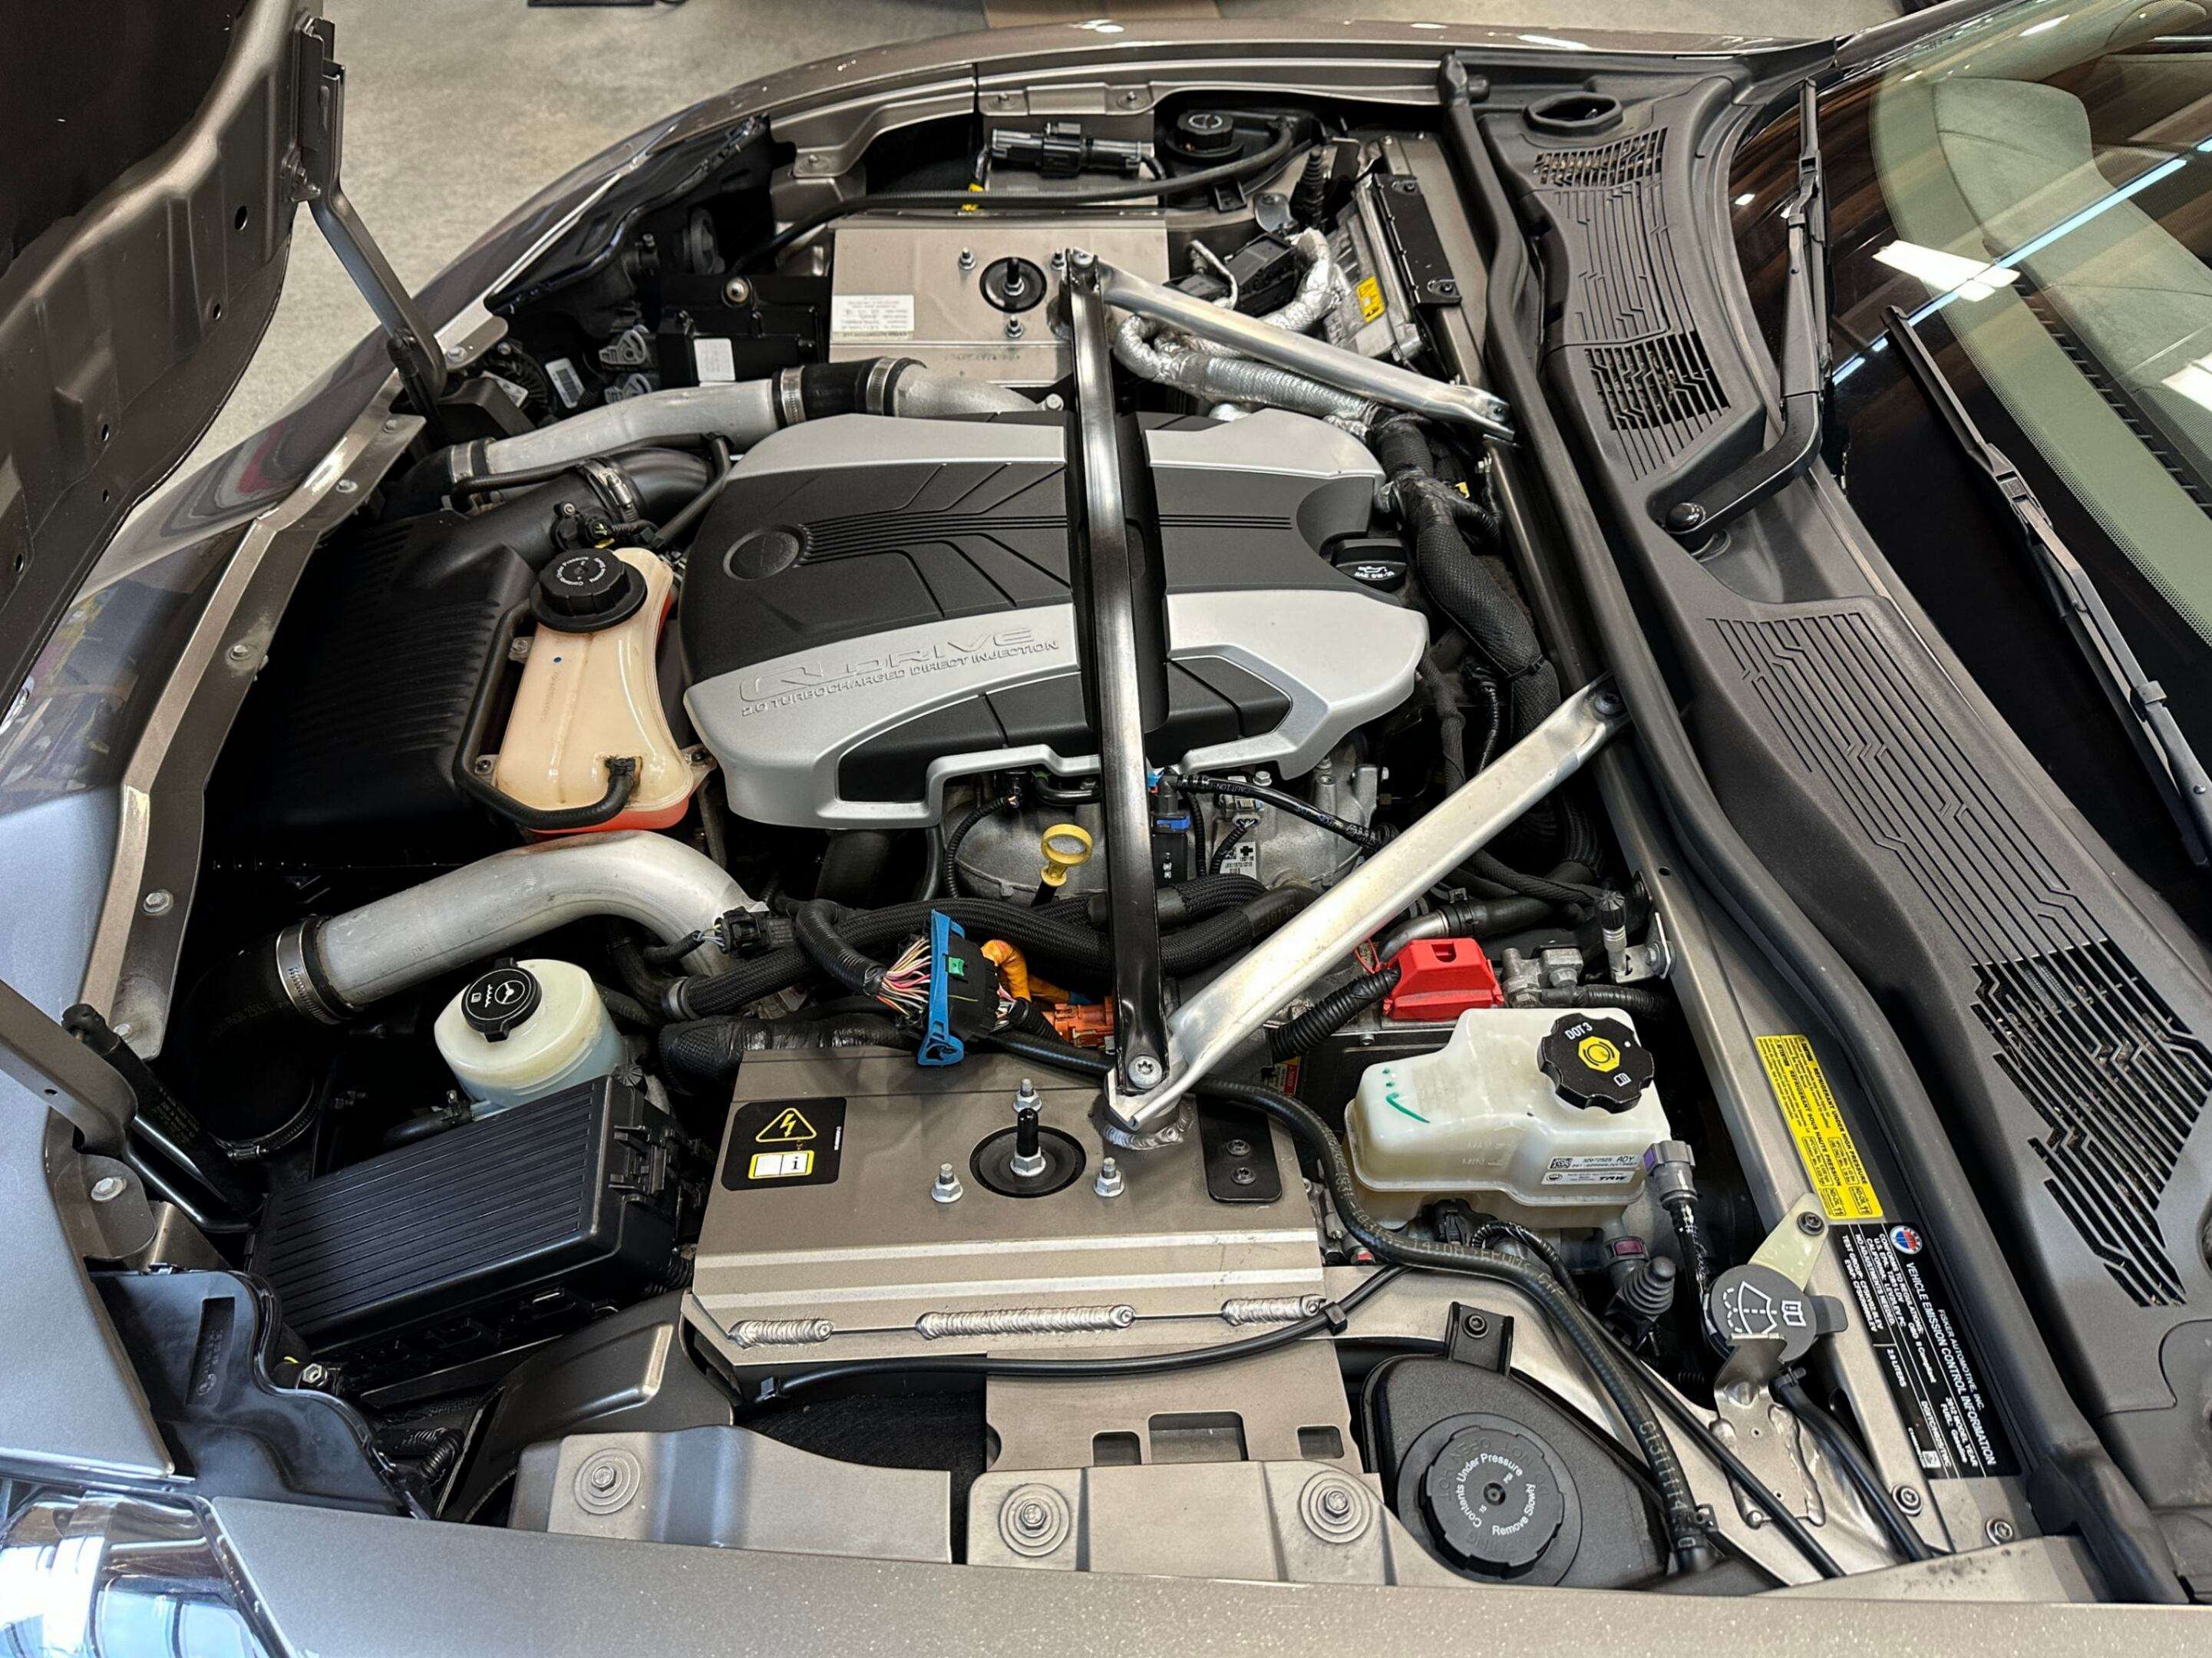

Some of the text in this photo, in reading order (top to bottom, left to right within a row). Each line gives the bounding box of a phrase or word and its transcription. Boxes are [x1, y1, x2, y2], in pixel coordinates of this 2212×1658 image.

[768, 669, 906, 709] TURBOCHARGED
[910, 656, 967, 679] DIRECT
[972, 640, 1060, 664] INJECTION
[1564, 1022, 1593, 1040] DOT 3
[1790, 1069, 1808, 1111] REFRIGERANT
[1807, 1113, 1818, 1130] SOUS
[1815, 1131, 1827, 1152] HAUTE
[1824, 1154, 1841, 1186] PRESSION
[1814, 1067, 1833, 1108] REFRIGERANT
[1832, 1110, 1844, 1131] UNDER
[1841, 1133, 1852, 1149] HIGH
[1849, 1150, 1867, 1184] PRESSURE
[1841, 1234, 1853, 1252] TEST
[1879, 1233, 1898, 1271] CONFORMS
[1893, 1271, 1903, 1282] TO
[1854, 1233, 1897, 1326] NO ADJUSTMENTS NEEDED.
[1890, 1360, 1907, 1387] LITERS
[1906, 1261, 1996, 1465] VEHICLE EMISSION CONTROL INFORMATION
[1917, 1347, 1936, 1383] Compliant
[1938, 1309, 1954, 1337] FISKER
[1973, 1393, 1985, 1411] INC.
[1945, 1396, 1979, 1467] 2012 MODEL YEAR
[1950, 1428, 1968, 1463] Gasoline
[1455, 1452, 1524, 1528] Contents Under Pressure
[1491, 1515, 1530, 1537] Remove
[1524, 1482, 1537, 1518] Slowly
